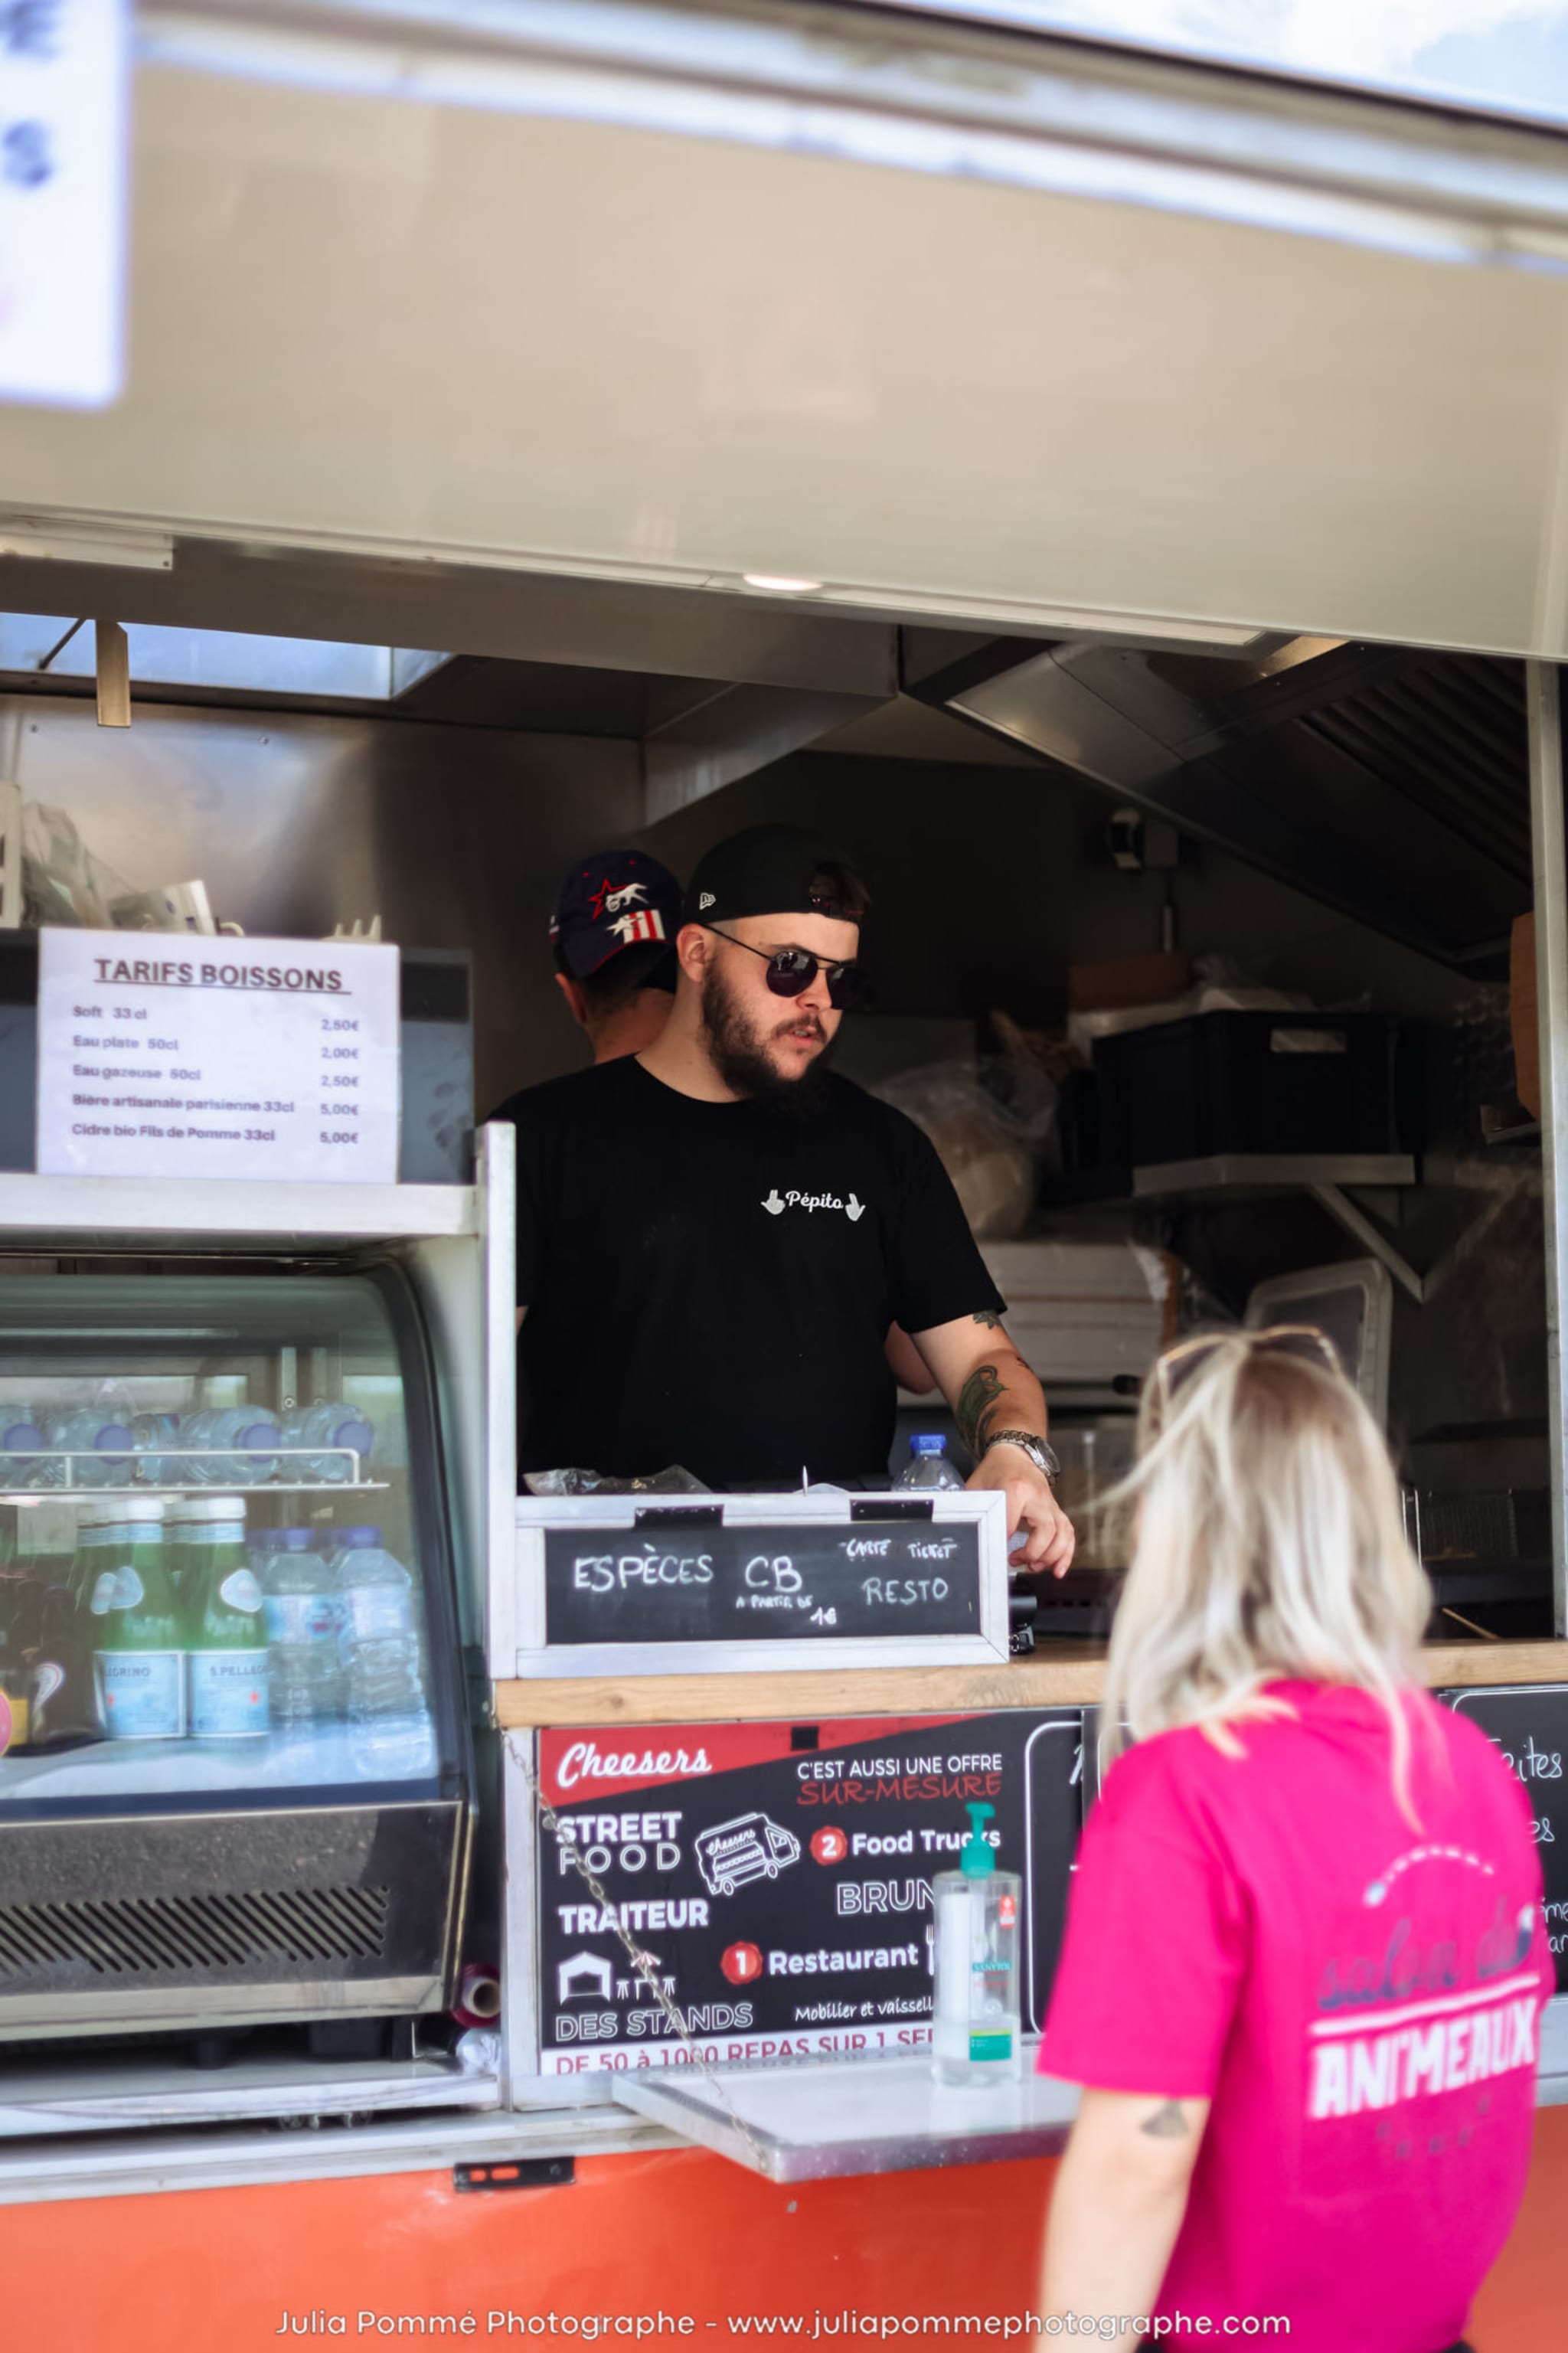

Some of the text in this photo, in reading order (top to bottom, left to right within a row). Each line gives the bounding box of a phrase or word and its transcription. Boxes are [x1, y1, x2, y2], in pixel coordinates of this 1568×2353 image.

[93, 959, 342, 991] TARIFS BOISSONS
[73, 1005, 359, 1031] Soft 33 cl 2,50€
[73, 1035, 359, 1059] Eau plate 50cl 2,00€
[73, 1064, 359, 1088] Eau gazeuse 50cl 2,50€
[73, 1094, 359, 1116] Bière artisanale parisienne 33cl 5,00€
[72, 1123, 358, 1144] Cidre bio Fils de Pomme 33cl 5,00€
[785, 1191, 843, 1213] Pépito
[574, 1542, 714, 1592] ESPÈCES
[744, 1555, 803, 1593] CB
[861, 1577, 949, 1606] RESTO
[557, 1742, 713, 1788] Cheesers
[797, 1753, 1002, 1779] C'EST AUSSI UNE OFFRE
[796, 1772, 1002, 1806] SUR-MESURE
[556, 1811, 683, 1844] STREET
[822, 1829, 1001, 1858] 2 Food Trucs
[560, 1842, 681, 1875] FOOD
[836, 1879, 934, 1915] BRUN
[558, 1899, 710, 1935] TRAITEUR
[735, 1943, 919, 1976] 1 Restaurant
[555, 2003, 754, 2043] DES STANDS
[795, 1995, 933, 2021] Mobilier et vaissell
[600, 2051, 629, 2071] 50
[638, 2048, 650, 2068] à
[877, 2031, 884, 2048] 1
